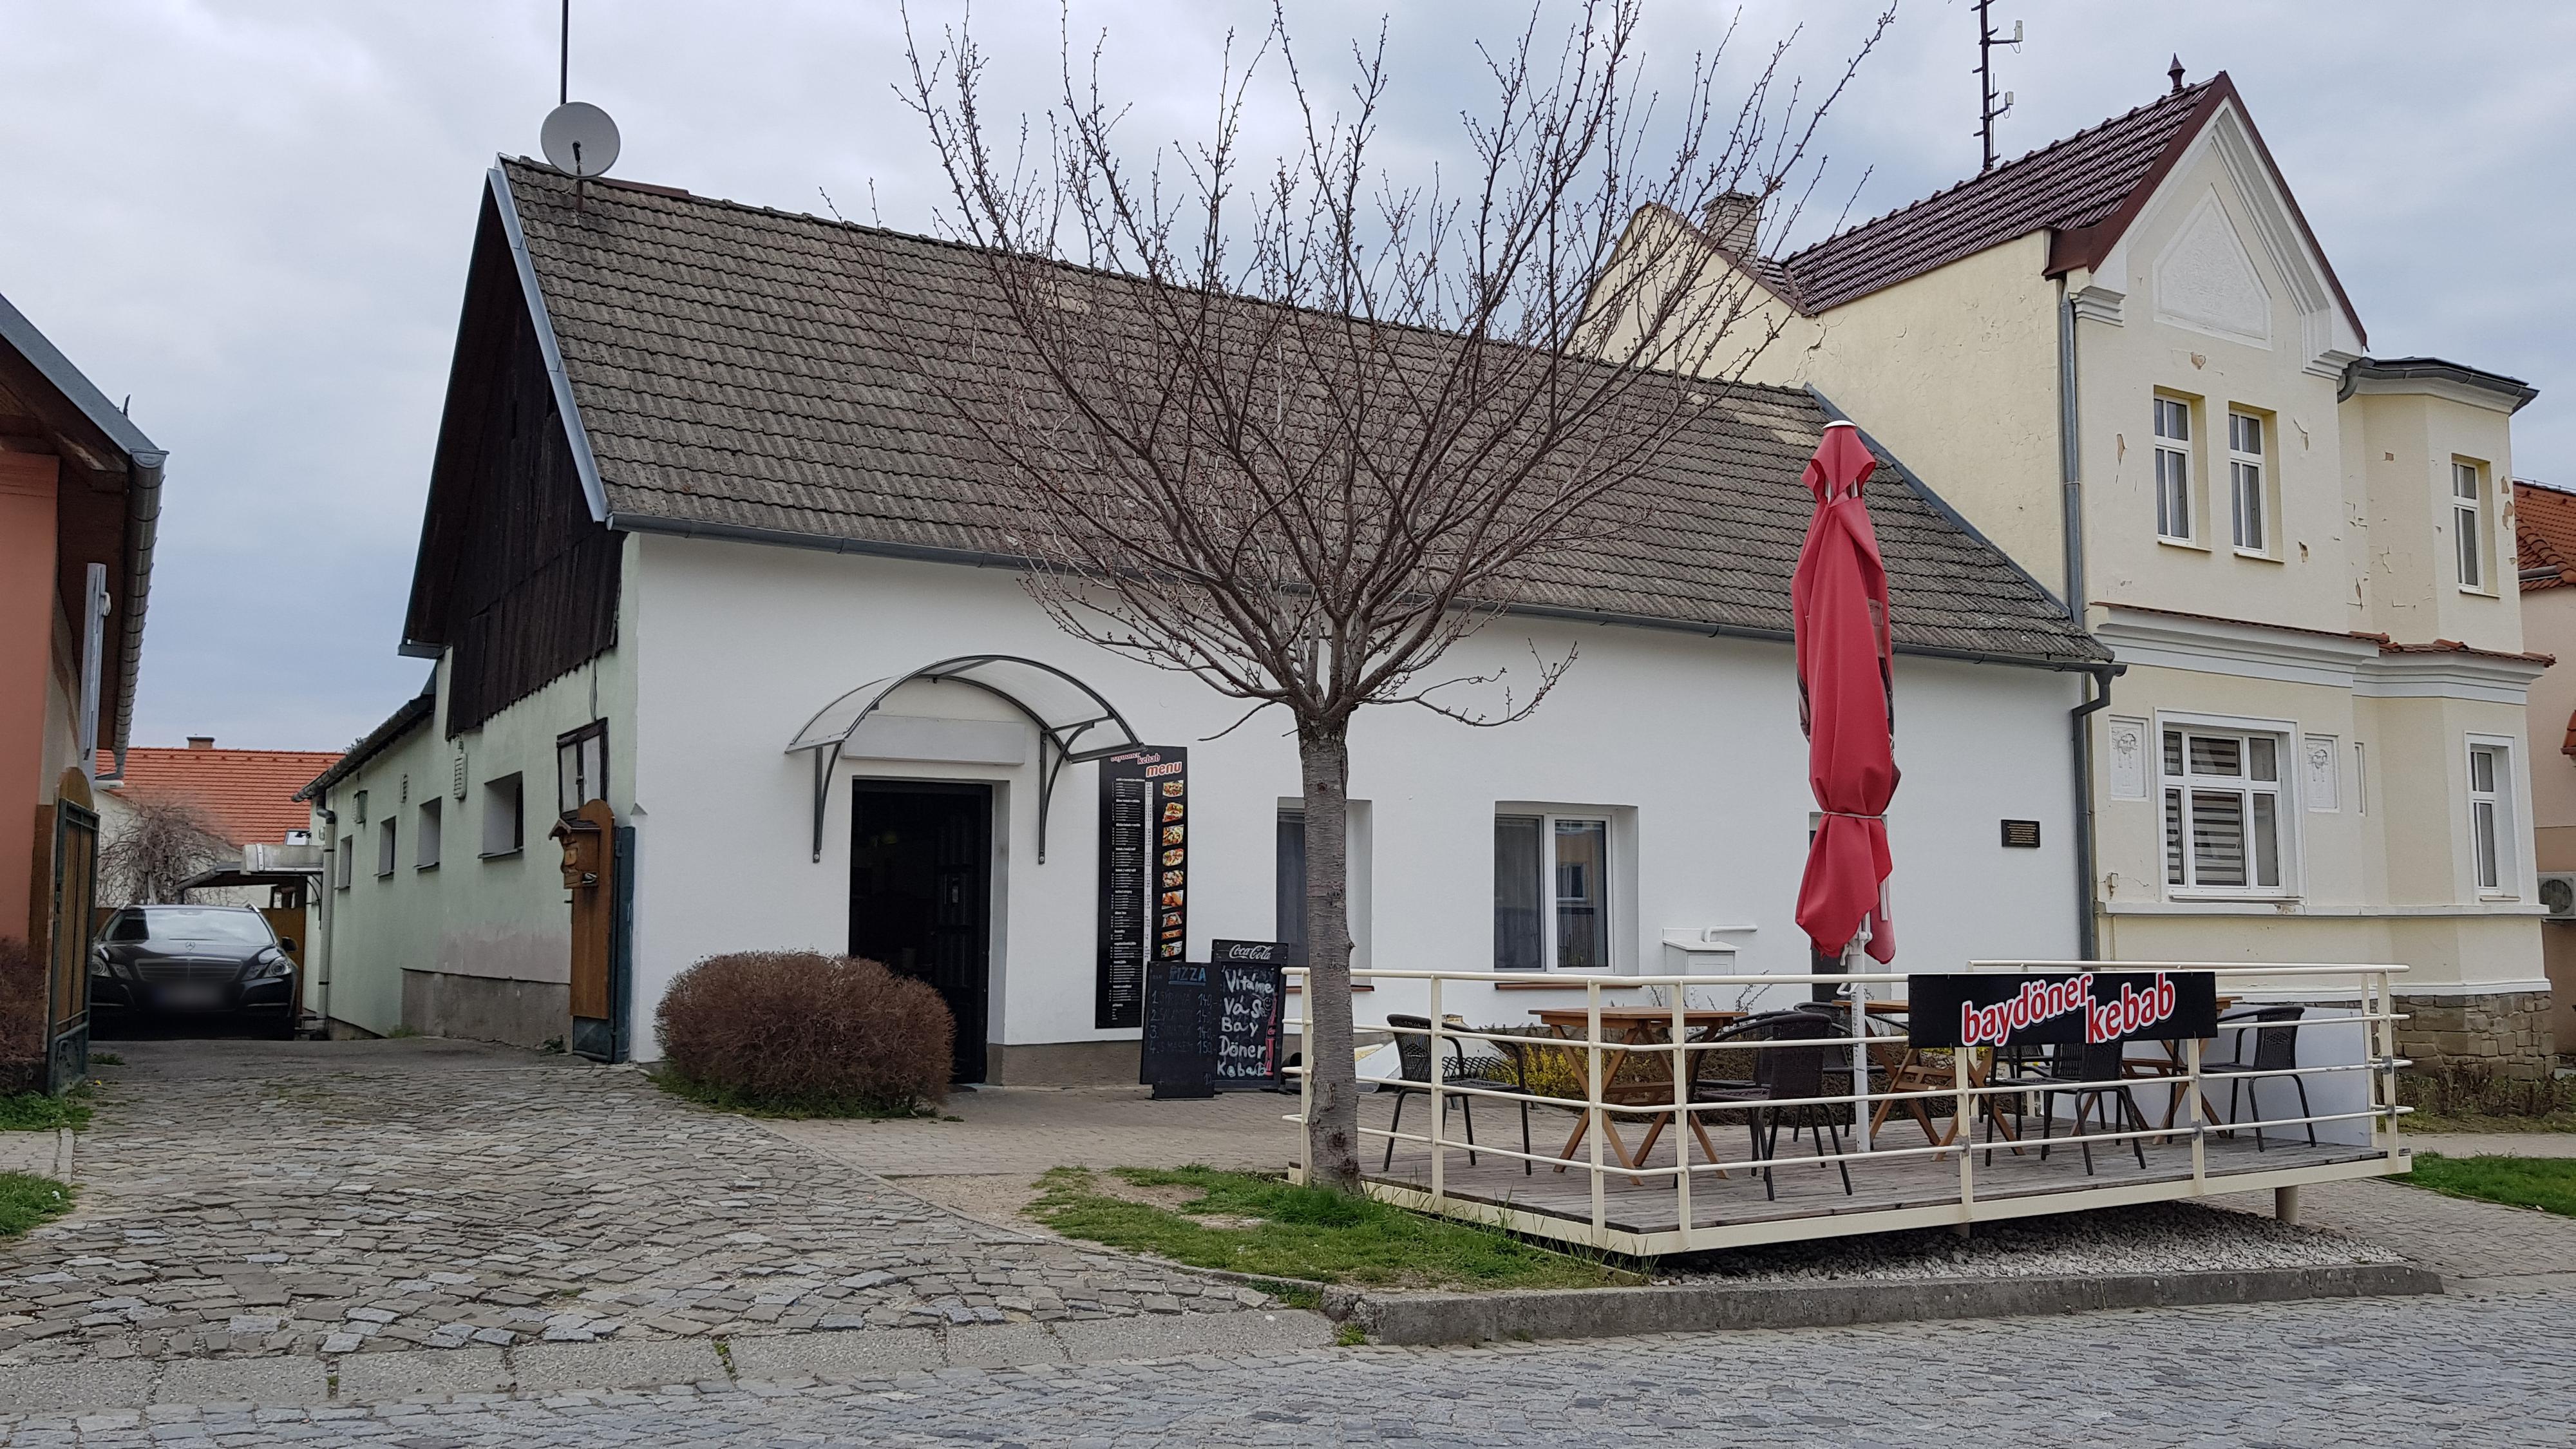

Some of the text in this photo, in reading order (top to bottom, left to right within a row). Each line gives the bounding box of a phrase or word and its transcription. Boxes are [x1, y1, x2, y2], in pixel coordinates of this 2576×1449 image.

[1137, 753, 1160, 765] kebab
[1146, 761, 1182, 778] menu
[1169, 966, 1206, 982] PIZZA
[1962, 972, 2175, 1047] baydöner kebab
[1221, 1017, 1258, 1037] Bay
[1218, 1035, 1266, 1059] Döner
